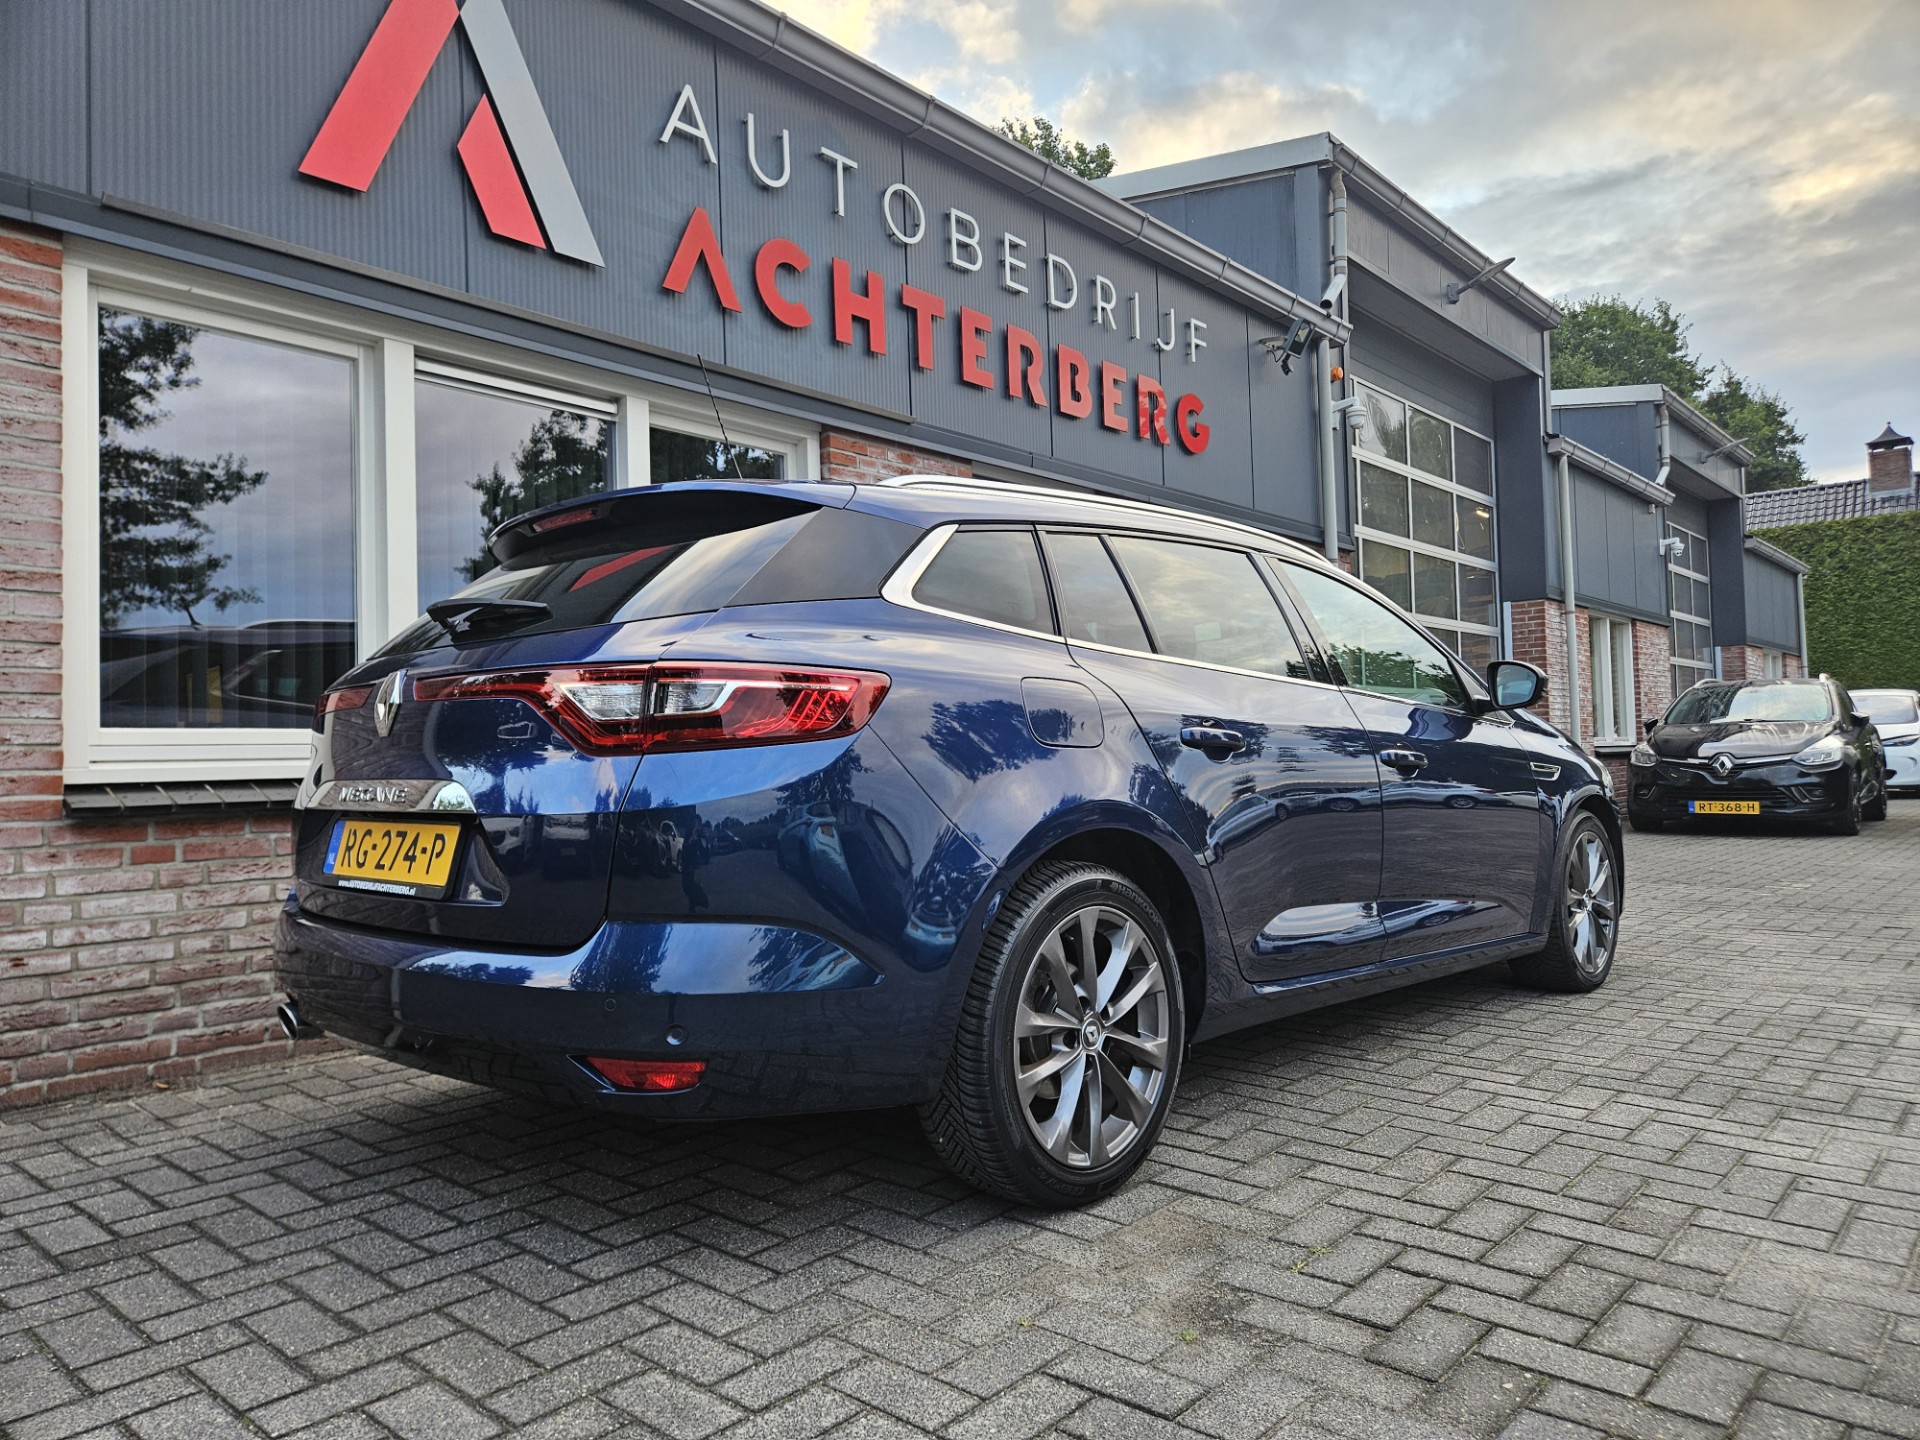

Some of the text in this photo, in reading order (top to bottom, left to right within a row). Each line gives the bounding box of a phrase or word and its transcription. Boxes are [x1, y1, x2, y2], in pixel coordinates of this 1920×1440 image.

[659, 83, 1208, 362] AUTOBEDRIJF
[662, 206, 1211, 454] ACHTERBERG
[341, 828, 446, 875] RG-274-P
[1699, 802, 1755, 813] RT-368-H
